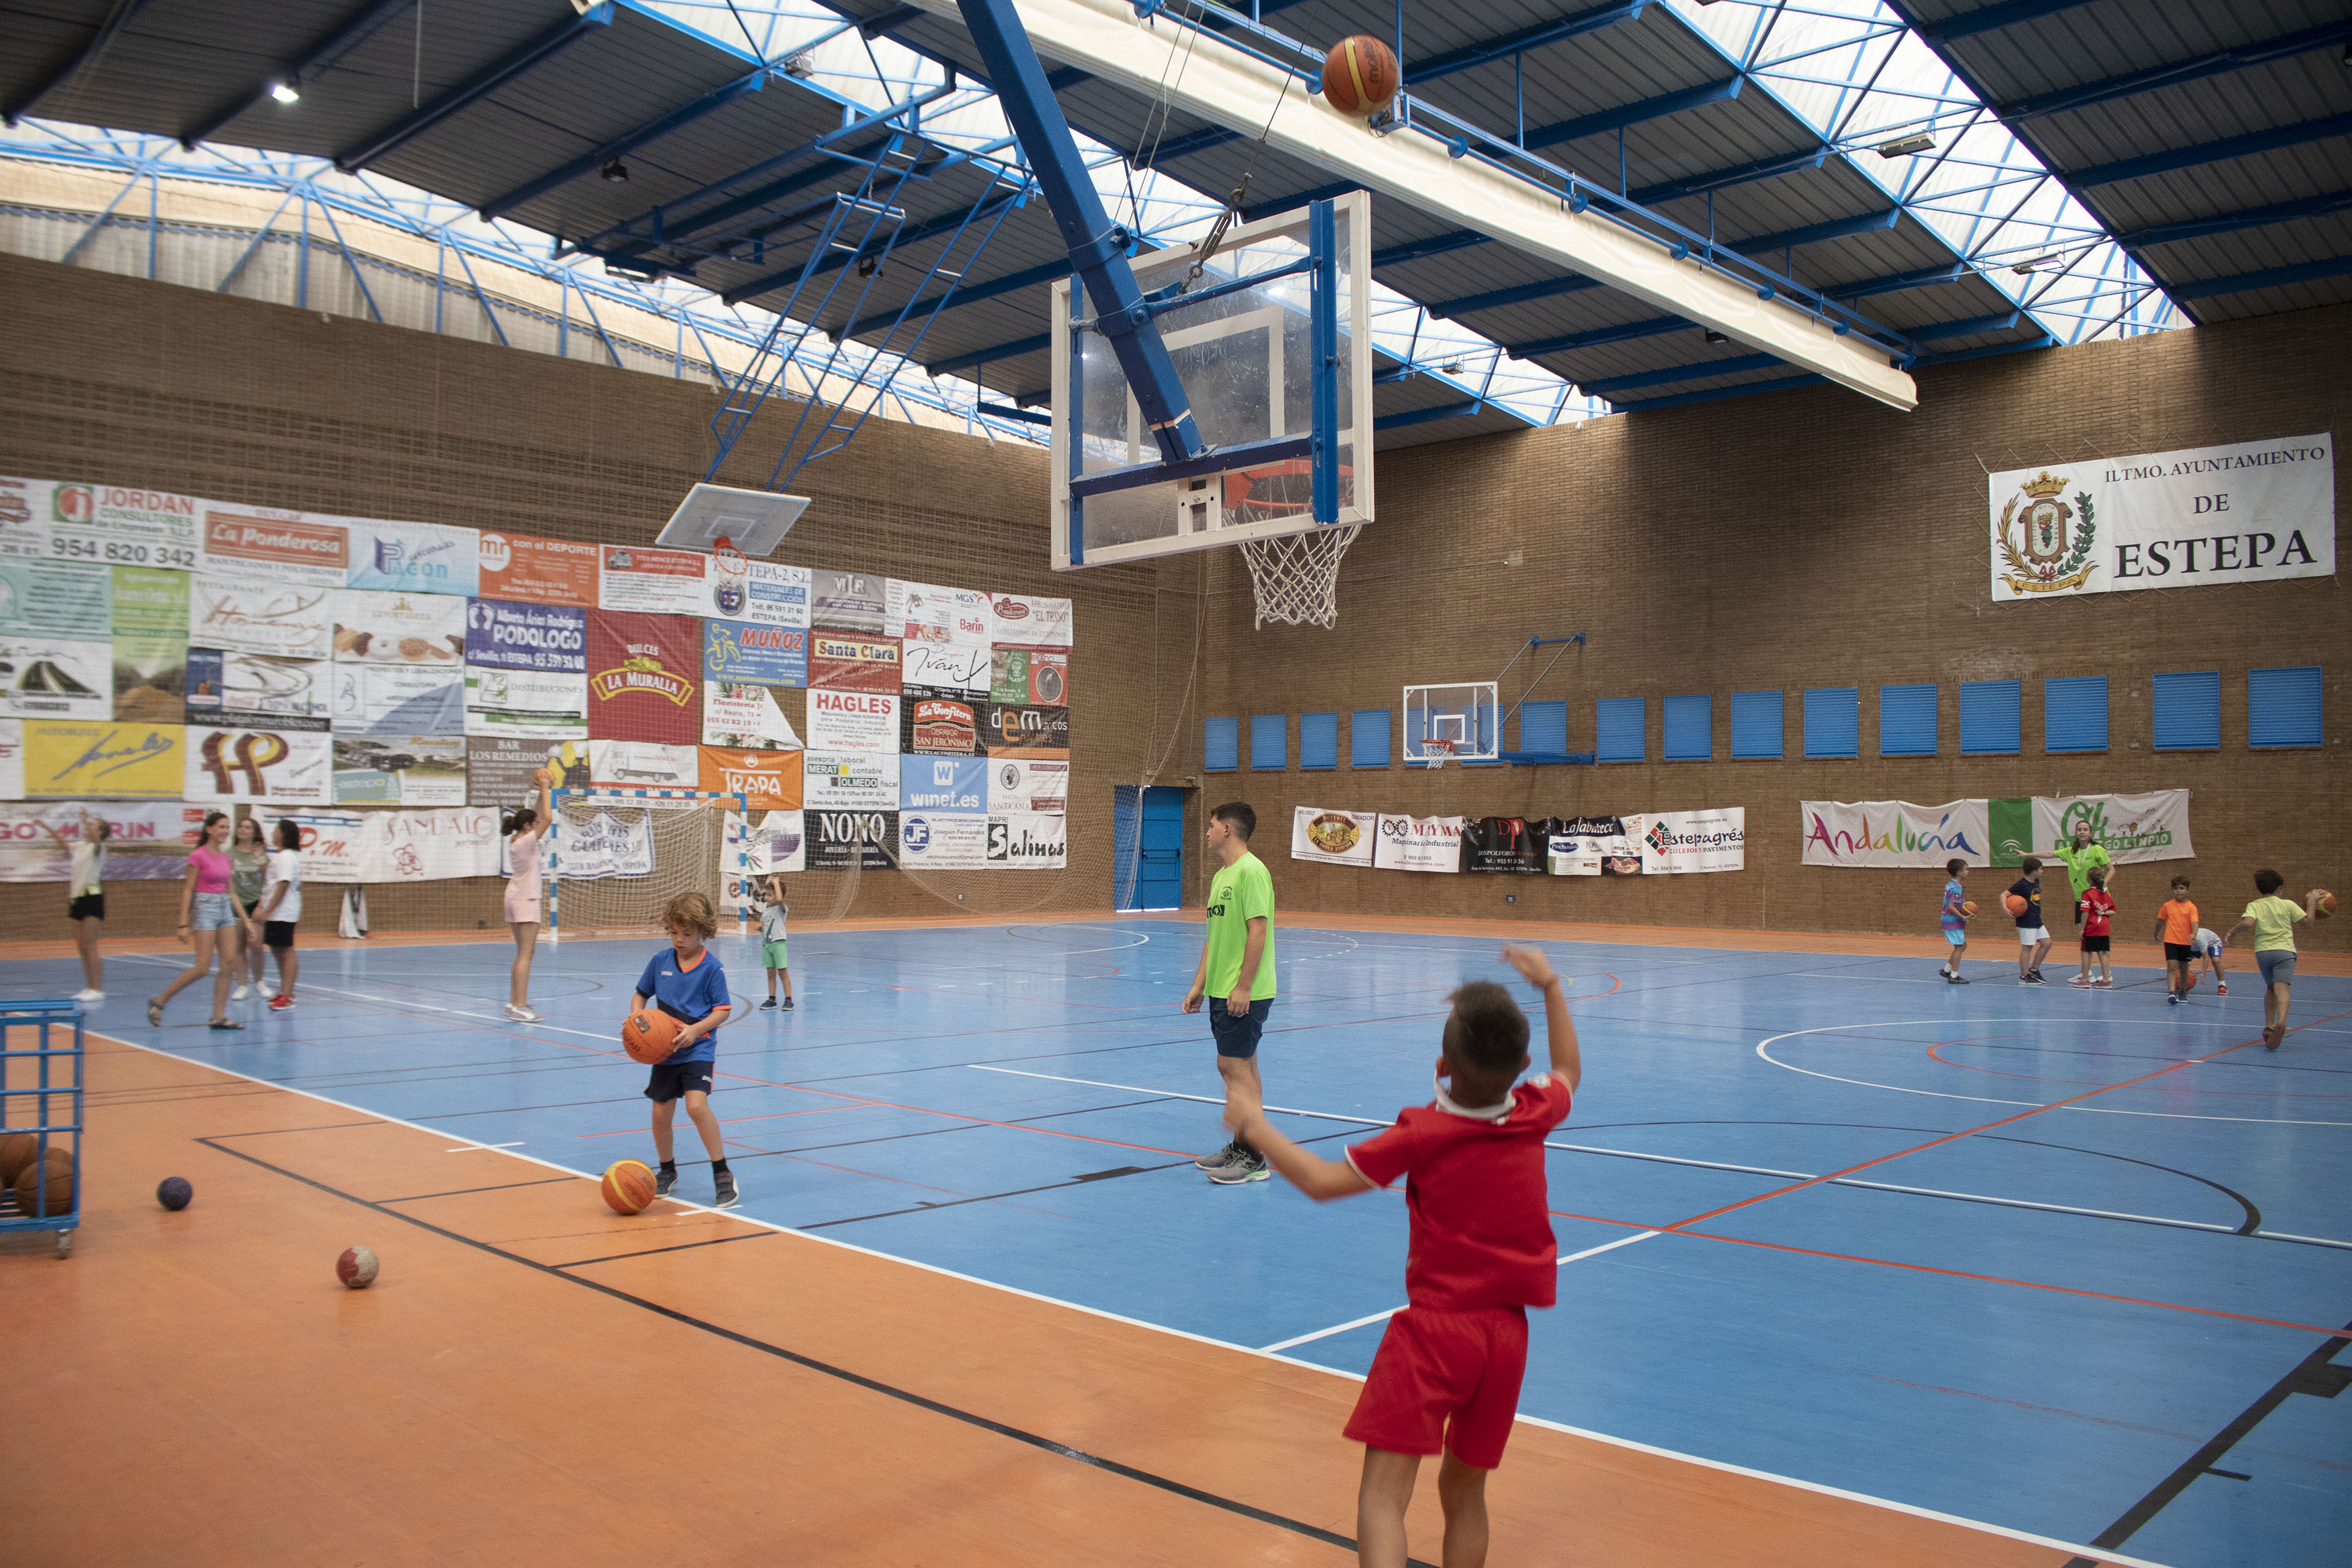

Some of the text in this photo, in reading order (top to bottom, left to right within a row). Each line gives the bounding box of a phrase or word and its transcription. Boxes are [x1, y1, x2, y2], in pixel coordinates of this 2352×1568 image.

[2105, 446, 2325, 484] ILTMO. AYUNTAMIENTO
[100, 488, 194, 515] JORDAN
[2193, 493, 2230, 514] DE
[212, 523, 238, 542] La
[240, 527, 341, 554] Ponderosa
[52, 538, 196, 567] 954 820 342
[512, 540, 533, 549] con
[546, 542, 597, 556] DEPORTE
[2114, 529, 2318, 579] ESTEPA
[752, 582, 793, 594] MATERIALES
[2021, 578, 2077, 591] ESTEPA
[955, 593, 975, 603] MGS
[751, 612, 777, 621] ESTEPA
[960, 617, 984, 633] Barin
[493, 623, 583, 650] PODOLOGO
[740, 627, 805, 651] MUÑOZ
[627, 643, 660, 657] DULCES
[819, 641, 856, 657] Santa
[861, 645, 895, 660] Clara
[607, 670, 678, 696] LA MURALLA
[817, 693, 892, 715] HAGLES
[918, 702, 972, 721] La Confitera
[931, 728, 958, 736] OBRADOR
[498, 740, 520, 750] BAR
[828, 739, 880, 748] www.hagles.com
[916, 736, 973, 748] SAN JERÓNIMO
[469, 751, 548, 762] LOS REMEDIOS
[807, 764, 838, 775] MERAT
[719, 767, 782, 796] TRAPA
[840, 777, 878, 787] OLMEDO
[909, 791, 980, 808] winet.es
[819, 813, 886, 843] NONO
[905, 826, 927, 843] JF
[1411, 824, 1462, 837] MAYMA
[1804, 811, 1982, 856] Andalucía
[988, 826, 1065, 858] Salinas
[1658, 828, 1745, 847] Estepagrés
[2124, 833, 2170, 849] LIMPIO
[1703, 844, 1745, 853] PAVIMENTOS
